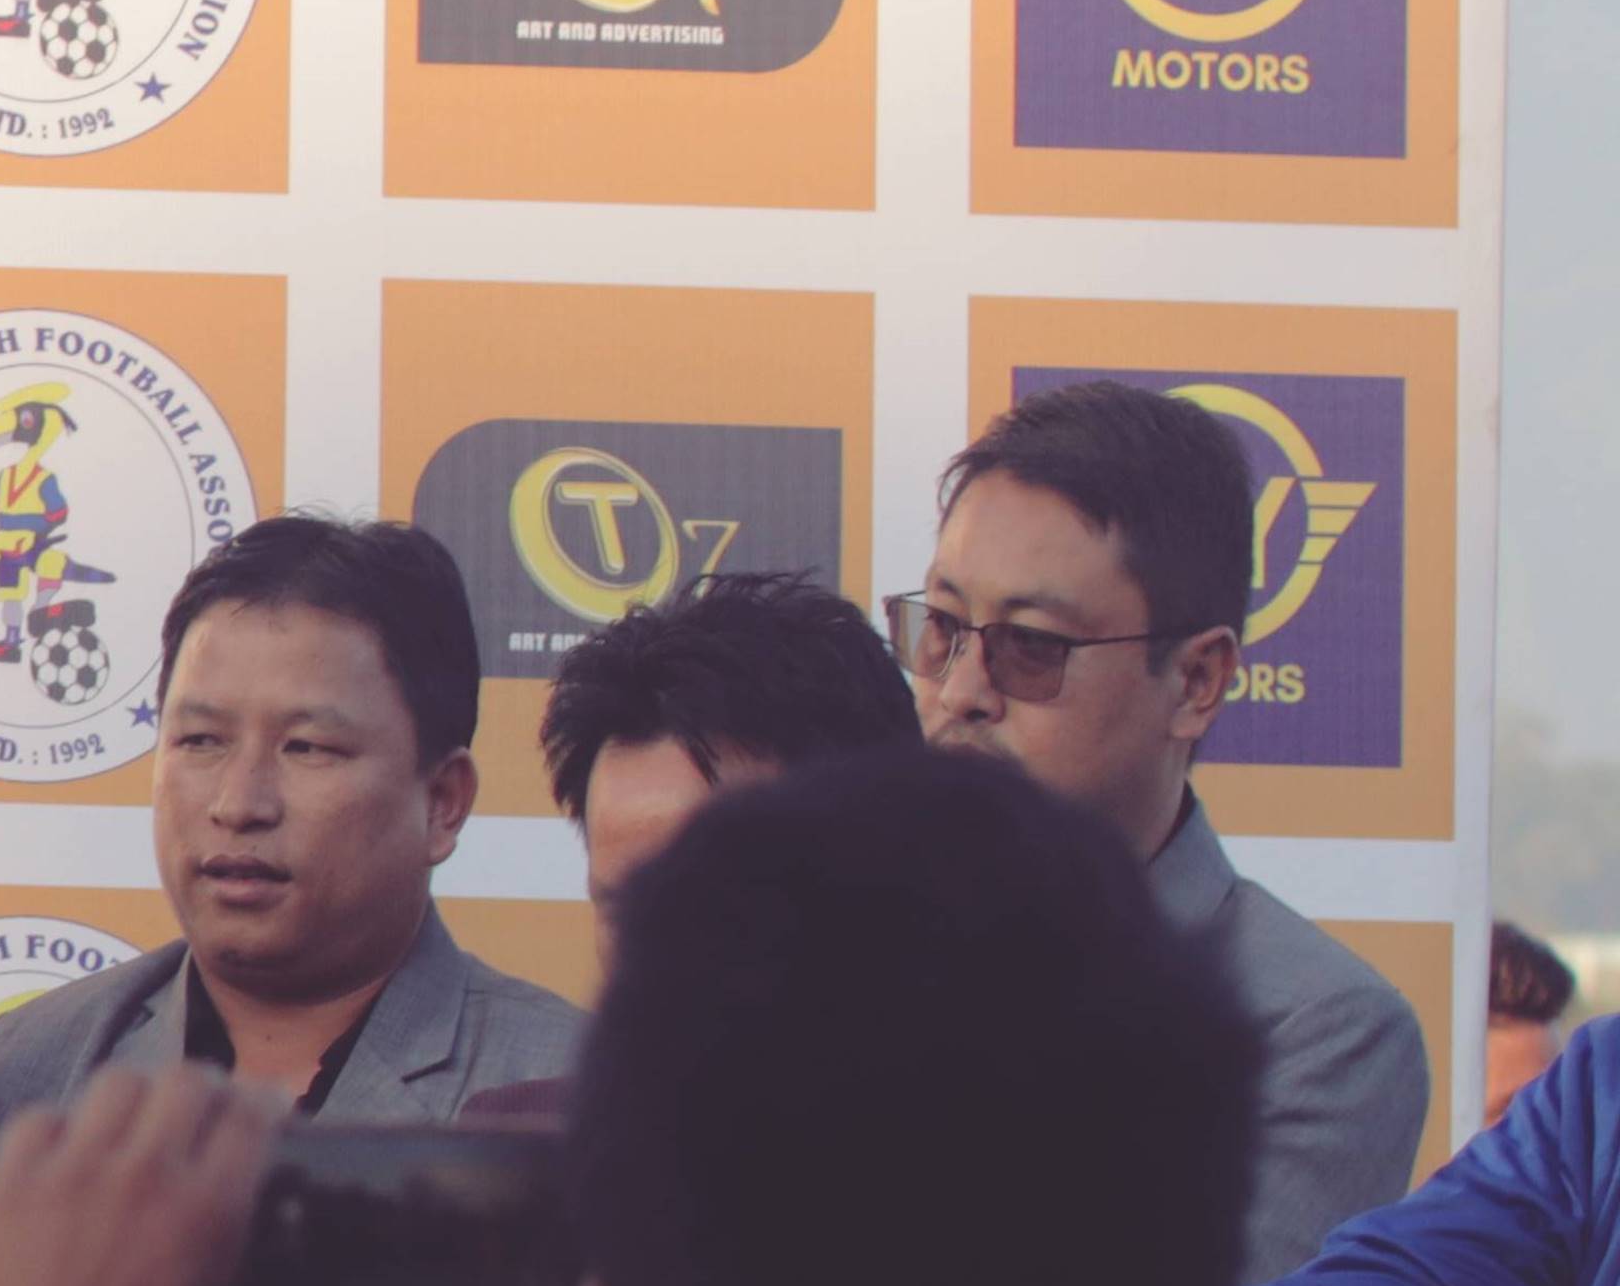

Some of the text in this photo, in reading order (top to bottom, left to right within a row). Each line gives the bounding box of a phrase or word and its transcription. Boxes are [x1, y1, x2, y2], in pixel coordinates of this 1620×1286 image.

[516, 20, 725, 45] ART AND ADVERTISING
[1111, 49, 1311, 95] MOTORS
[58, 108, 116, 140] 1992
[35, 328, 202, 447] FOOTBALL
[50, 734, 106, 765] 1992
